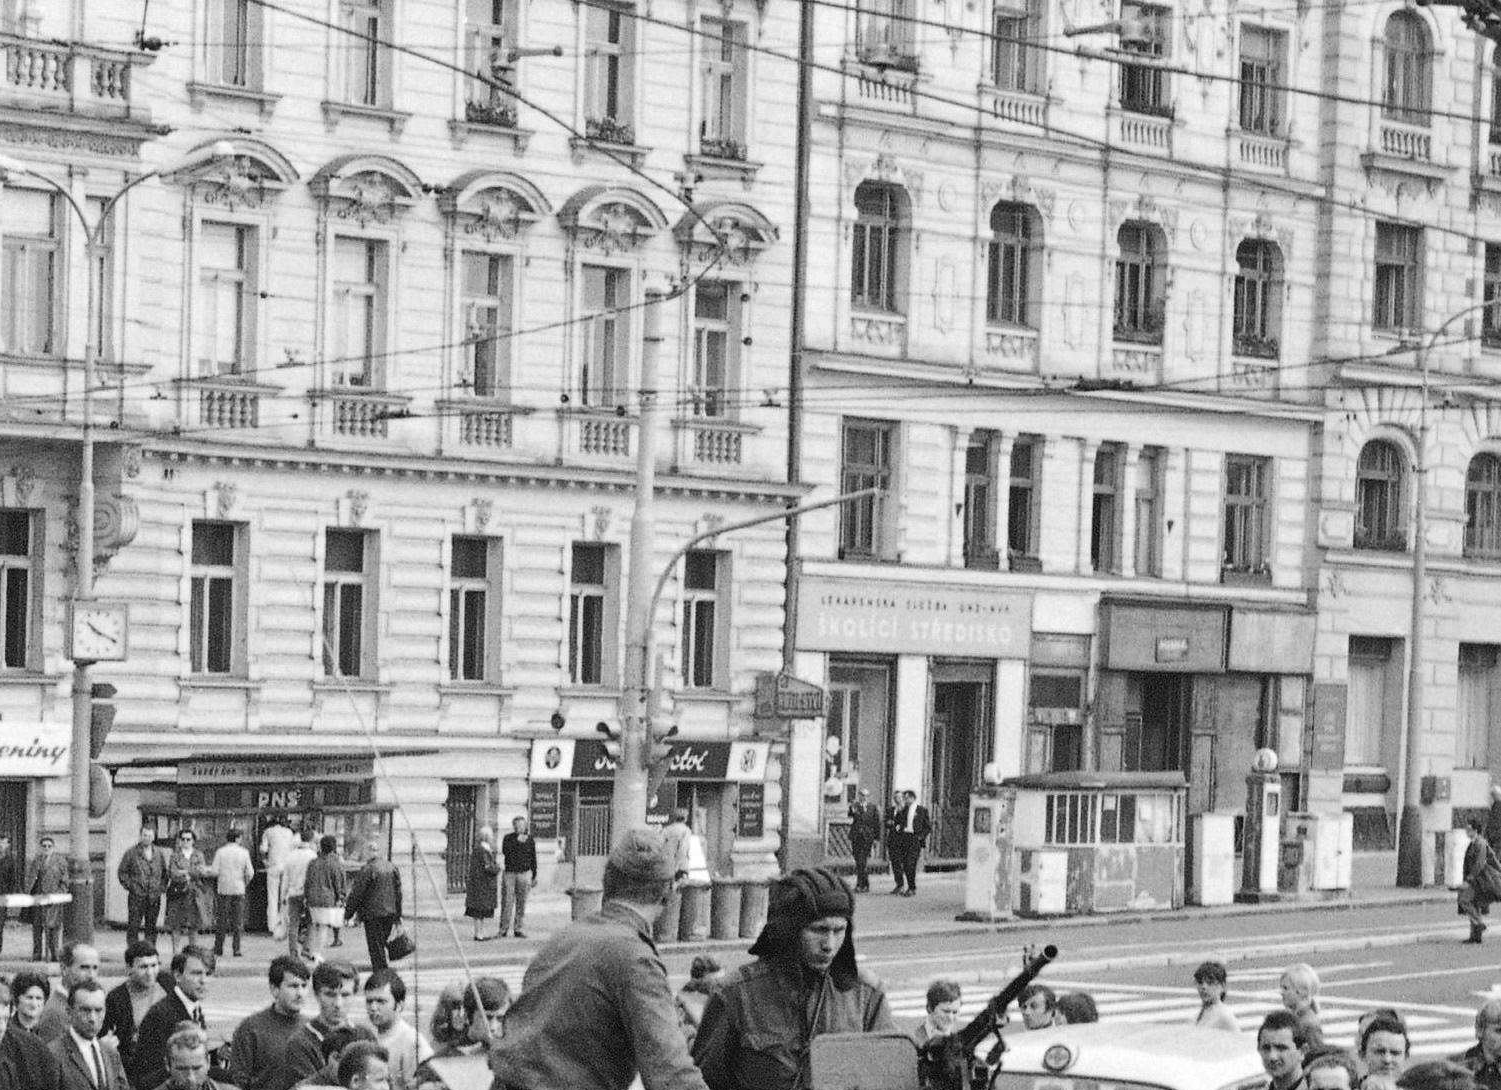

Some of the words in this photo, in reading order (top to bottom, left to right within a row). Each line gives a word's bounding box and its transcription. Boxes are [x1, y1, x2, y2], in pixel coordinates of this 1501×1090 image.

[819, 611, 898, 638] ŠKOLÍCÍ
[910, 615, 1013, 644] STŘEDISKO
[258, 791, 298, 808] PNS
